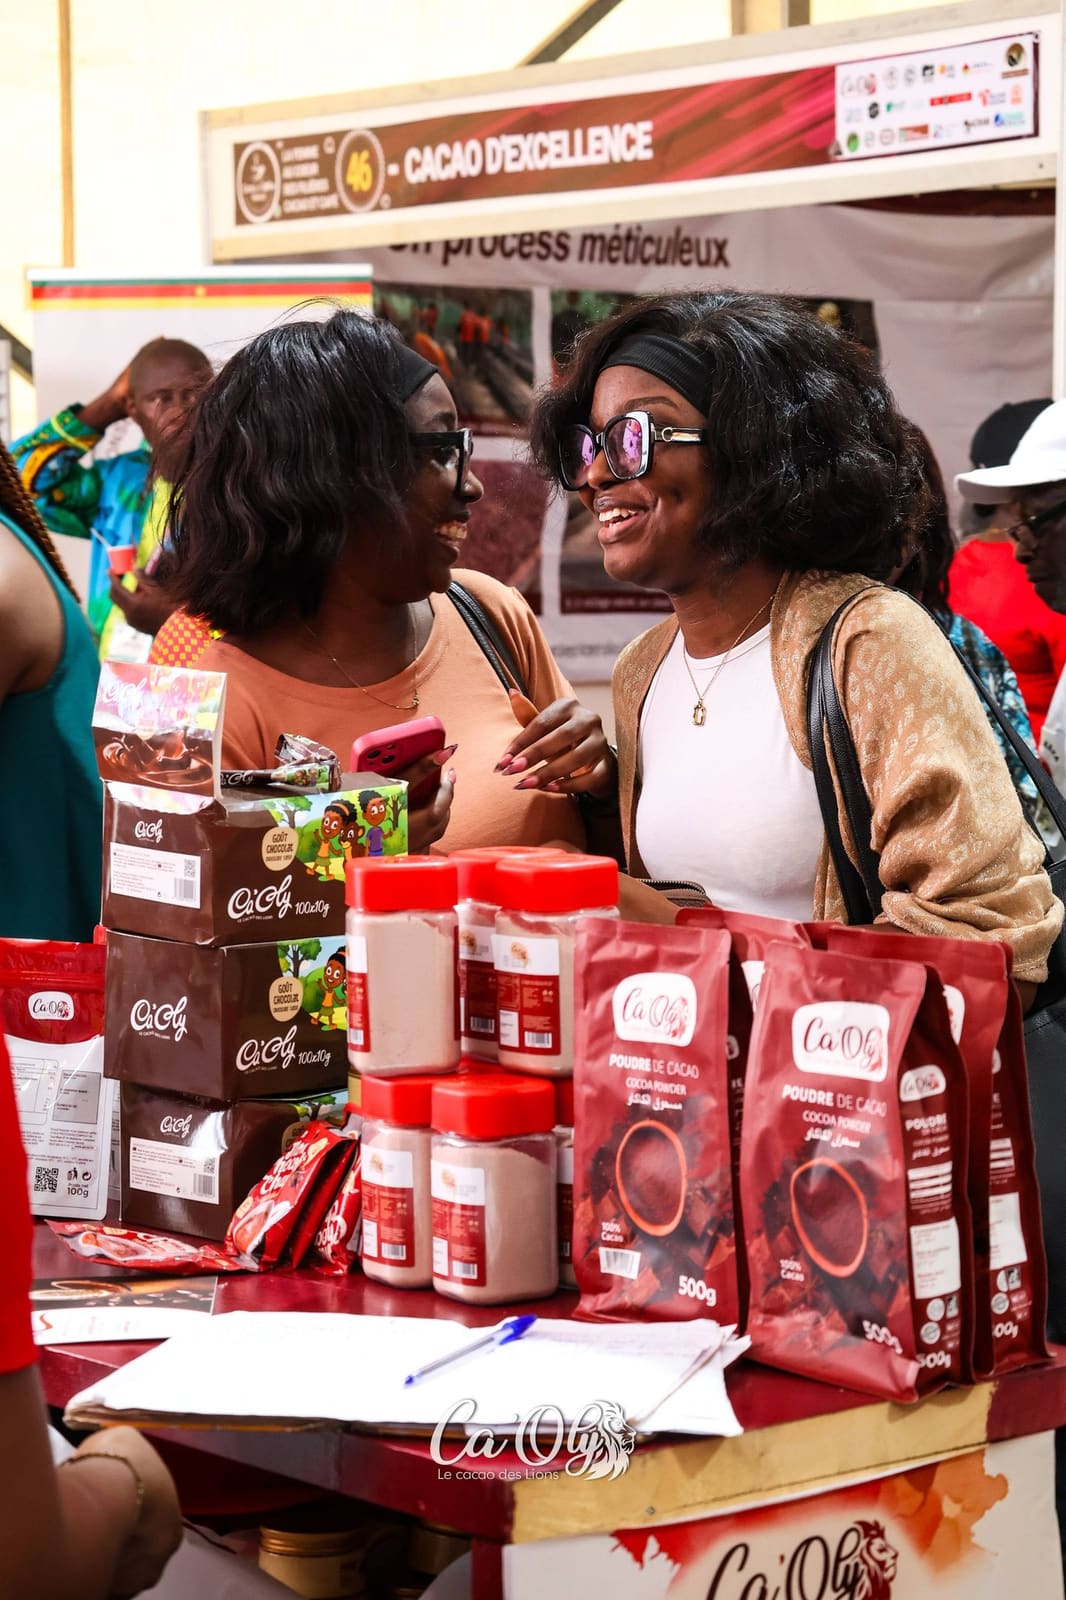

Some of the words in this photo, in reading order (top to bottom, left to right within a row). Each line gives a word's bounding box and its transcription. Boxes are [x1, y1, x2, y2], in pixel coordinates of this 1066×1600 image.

[346, 150, 372, 192] 46
[404, 139, 484, 184] CACAO
[485, 121, 654, 175] D'EXCELLENCE
[442, 230, 570, 265] process
[579, 223, 730, 268] méticuleux
[272, 831, 288, 843] GOÛT
[227, 874, 292, 919] Ca'Oly
[295, 900, 330, 918] 100x10g
[278, 981, 293, 994] GOÛT
[130, 996, 188, 1042] Ca'Oly
[235, 1025, 298, 1071] Ca'Oly
[298, 1049, 331, 1068] 100x10g
[609, 1053, 651, 1072] POUDRE
[652, 1059, 665, 1074] DE
[666, 1061, 700, 1079] CACAO
[625, 1076, 654, 1091] COCOA
[654, 1080, 687, 1096] POWDER
[781, 1083, 834, 1107] POUDRE
[836, 1092, 854, 1111] DE
[855, 1096, 887, 1117] CACAO
[802, 1110, 837, 1127] COCOA
[67, 1187, 89, 1198] 100g
[601, 1231, 624, 1243] Cacao
[678, 1274, 717, 1307] 500g
